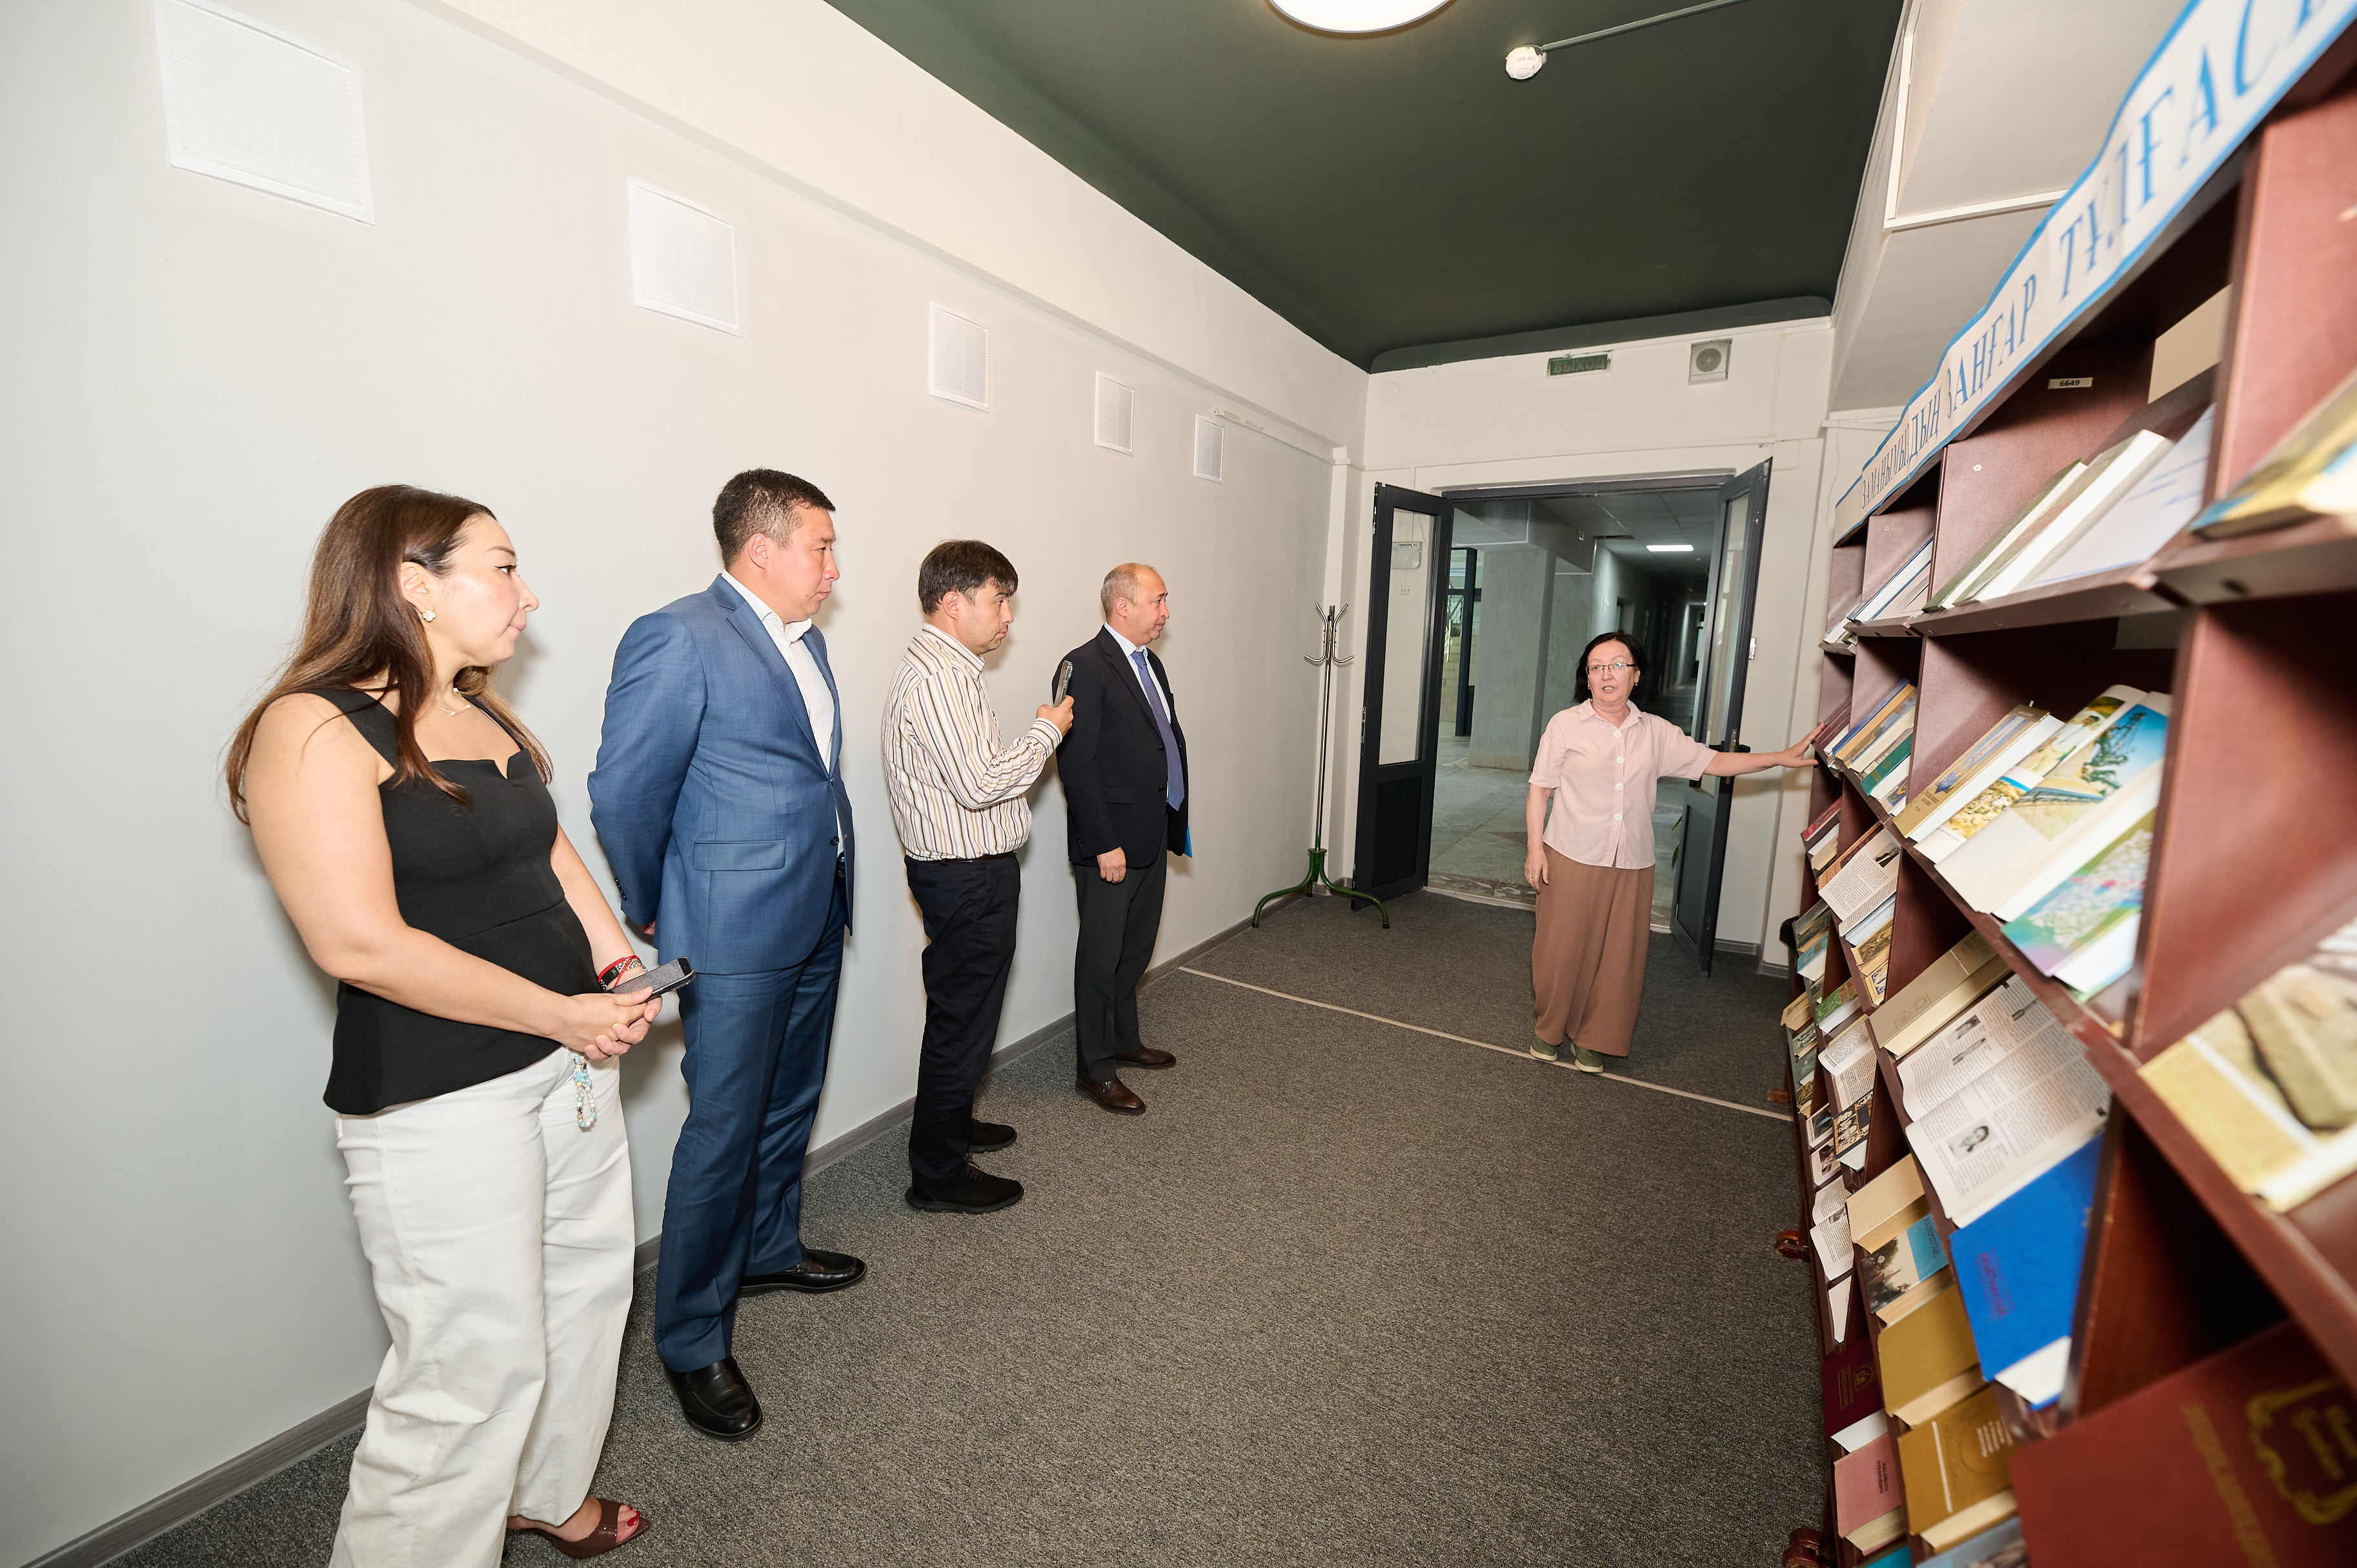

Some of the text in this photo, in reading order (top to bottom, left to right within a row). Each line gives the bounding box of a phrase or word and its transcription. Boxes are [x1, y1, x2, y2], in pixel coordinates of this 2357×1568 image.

[1946, 274, 2037, 419] ЗАҢҒАР
[2059, 0, 2325, 303] ТҰЛҒАС
[1553, 357, 1605, 374] ВЫХОД
